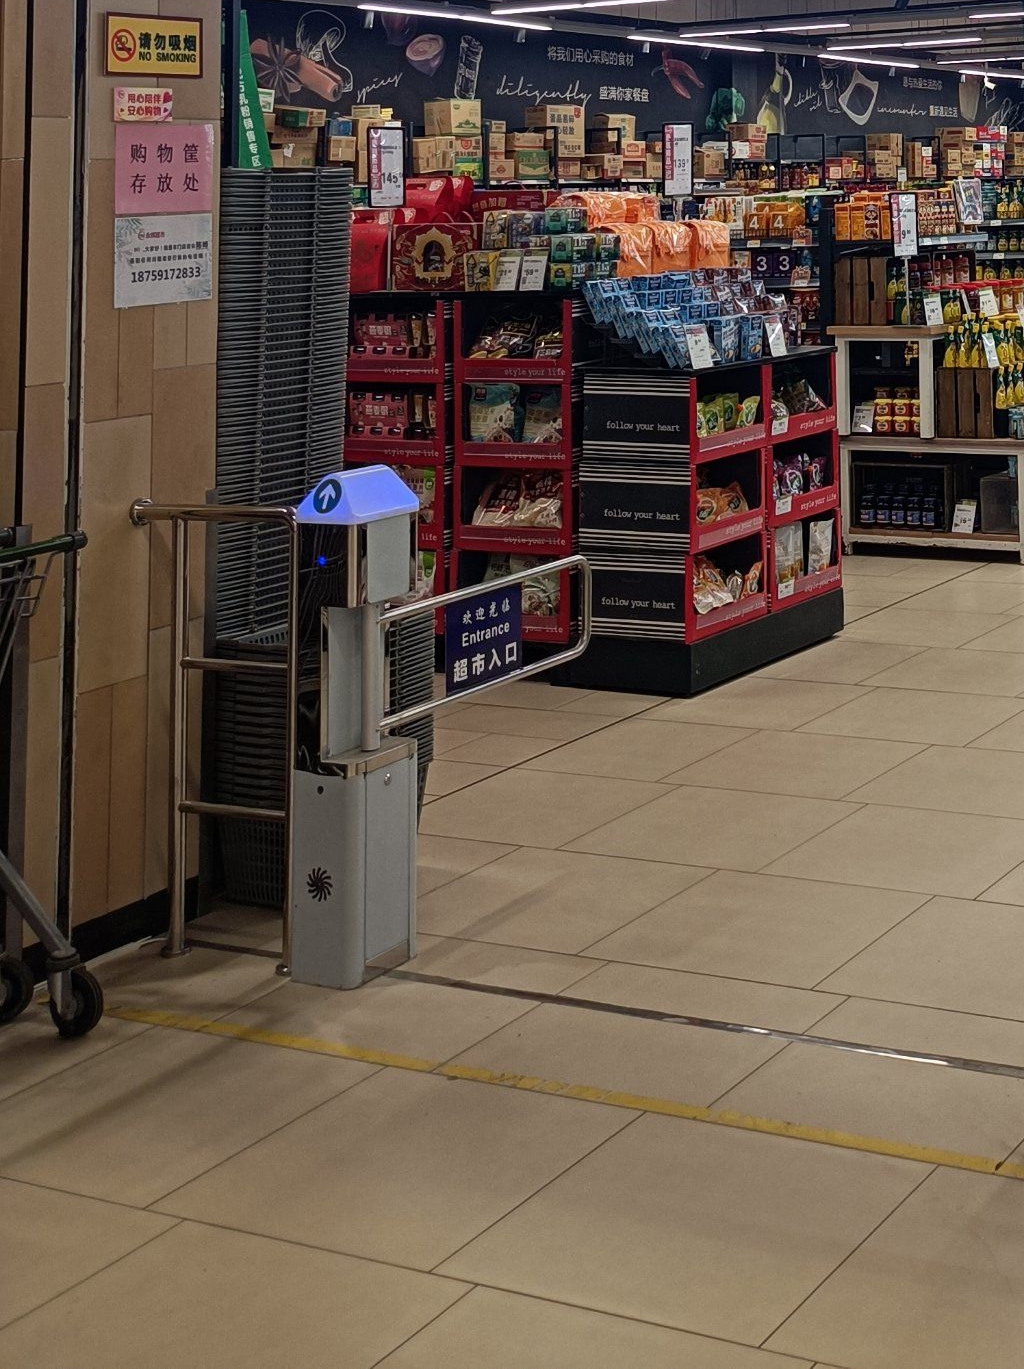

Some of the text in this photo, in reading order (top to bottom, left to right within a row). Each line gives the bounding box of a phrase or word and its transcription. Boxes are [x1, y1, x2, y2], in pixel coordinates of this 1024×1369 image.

[138, 32, 198, 52] 请勿吸烟
[138, 51, 197, 63] NO SMOKING
[548, 45, 634, 67] 将我们用心采购的食材
[496, 74, 592, 107] diligently
[599, 86, 650, 102] 盛满你家餐盘
[127, 93, 162, 105] 用心陪伴
[127, 105, 162, 117] 安心购物
[130, 142, 199, 164] 购物筐
[130, 172, 199, 194] 存放处
[749, 216, 760, 229] 4
[773, 215, 784, 229] 4
[756, 256, 767, 271] 3
[779, 255, 790, 271] 3
[131, 266, 201, 283] 18759172833
[504, 367, 566, 378] style your life
[606, 420, 681, 432] follow your heart
[801, 492, 837, 511] style your life
[603, 508, 681, 521] follow your heart
[462, 597, 511, 625] 欢迎光临
[601, 597, 676, 610] follow your heart
[461, 621, 510, 647] Entrance
[453, 641, 517, 684] 超市入口
